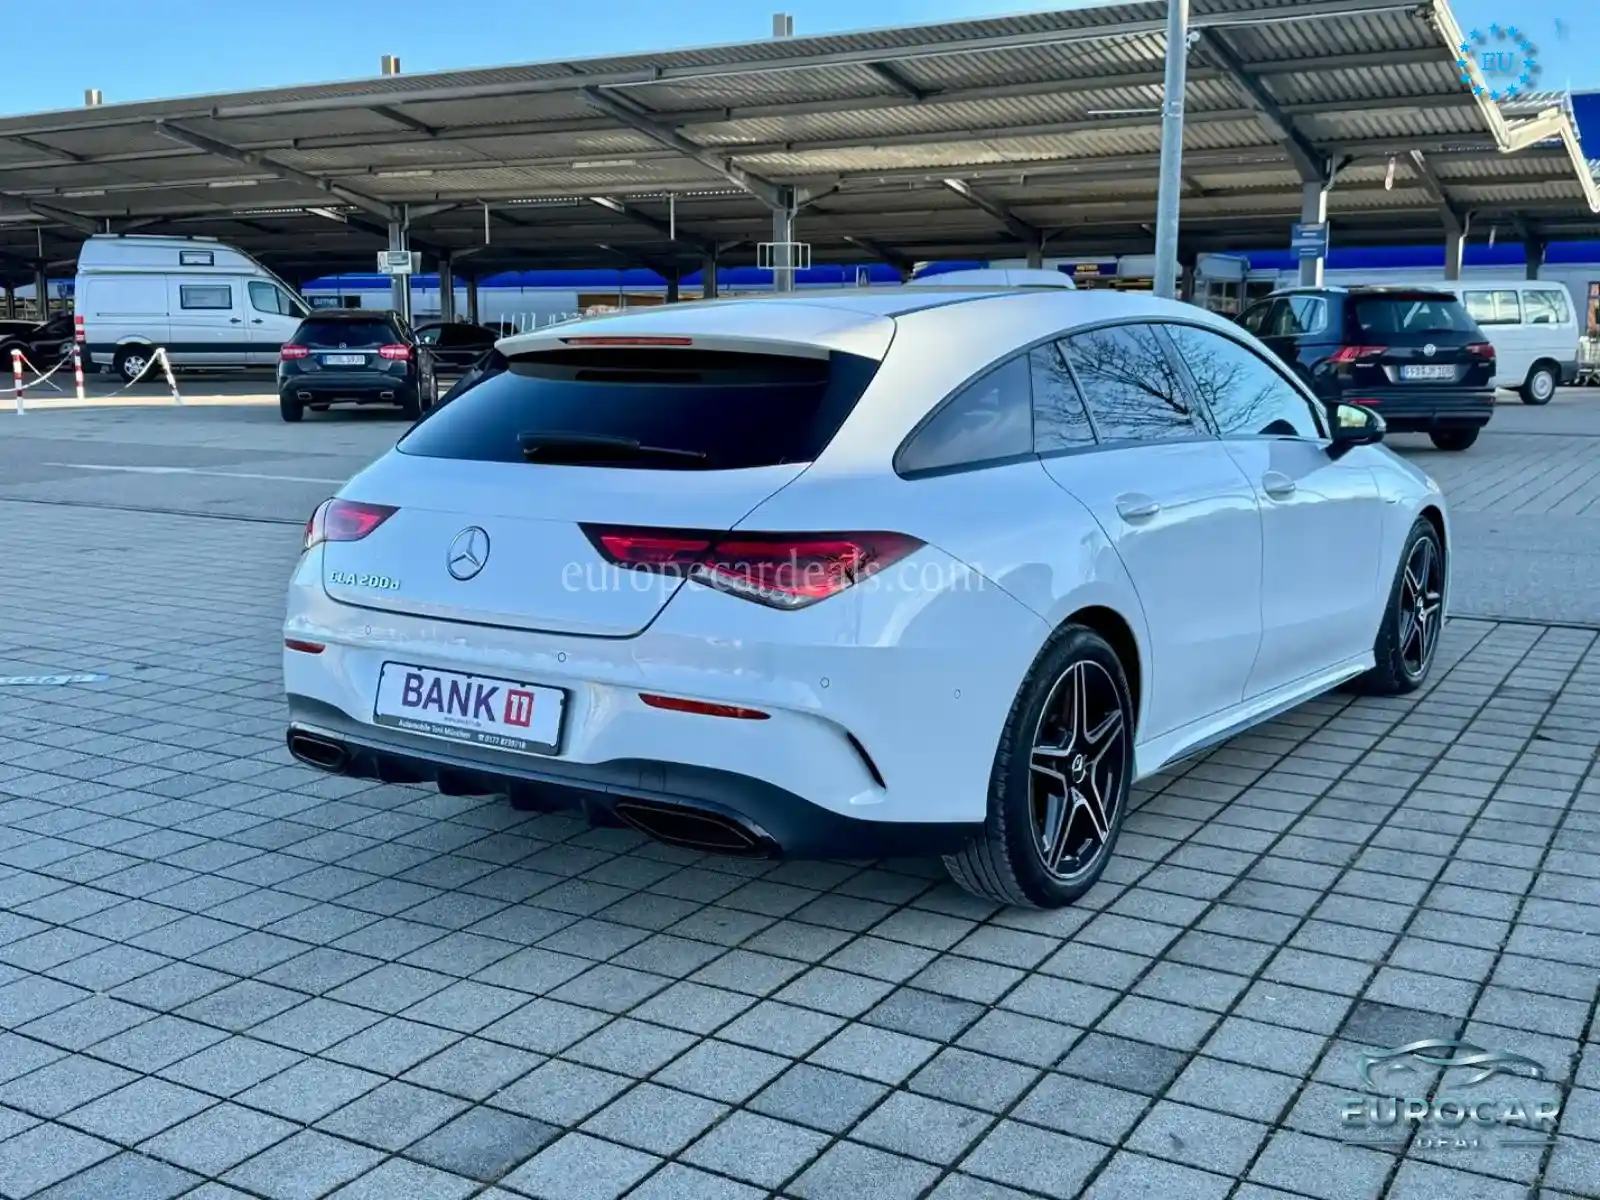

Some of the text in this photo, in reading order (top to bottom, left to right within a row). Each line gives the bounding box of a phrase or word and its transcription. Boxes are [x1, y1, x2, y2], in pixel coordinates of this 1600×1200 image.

[330, 571, 357, 586] CLA
[402, 672, 530, 723] BANK 11
